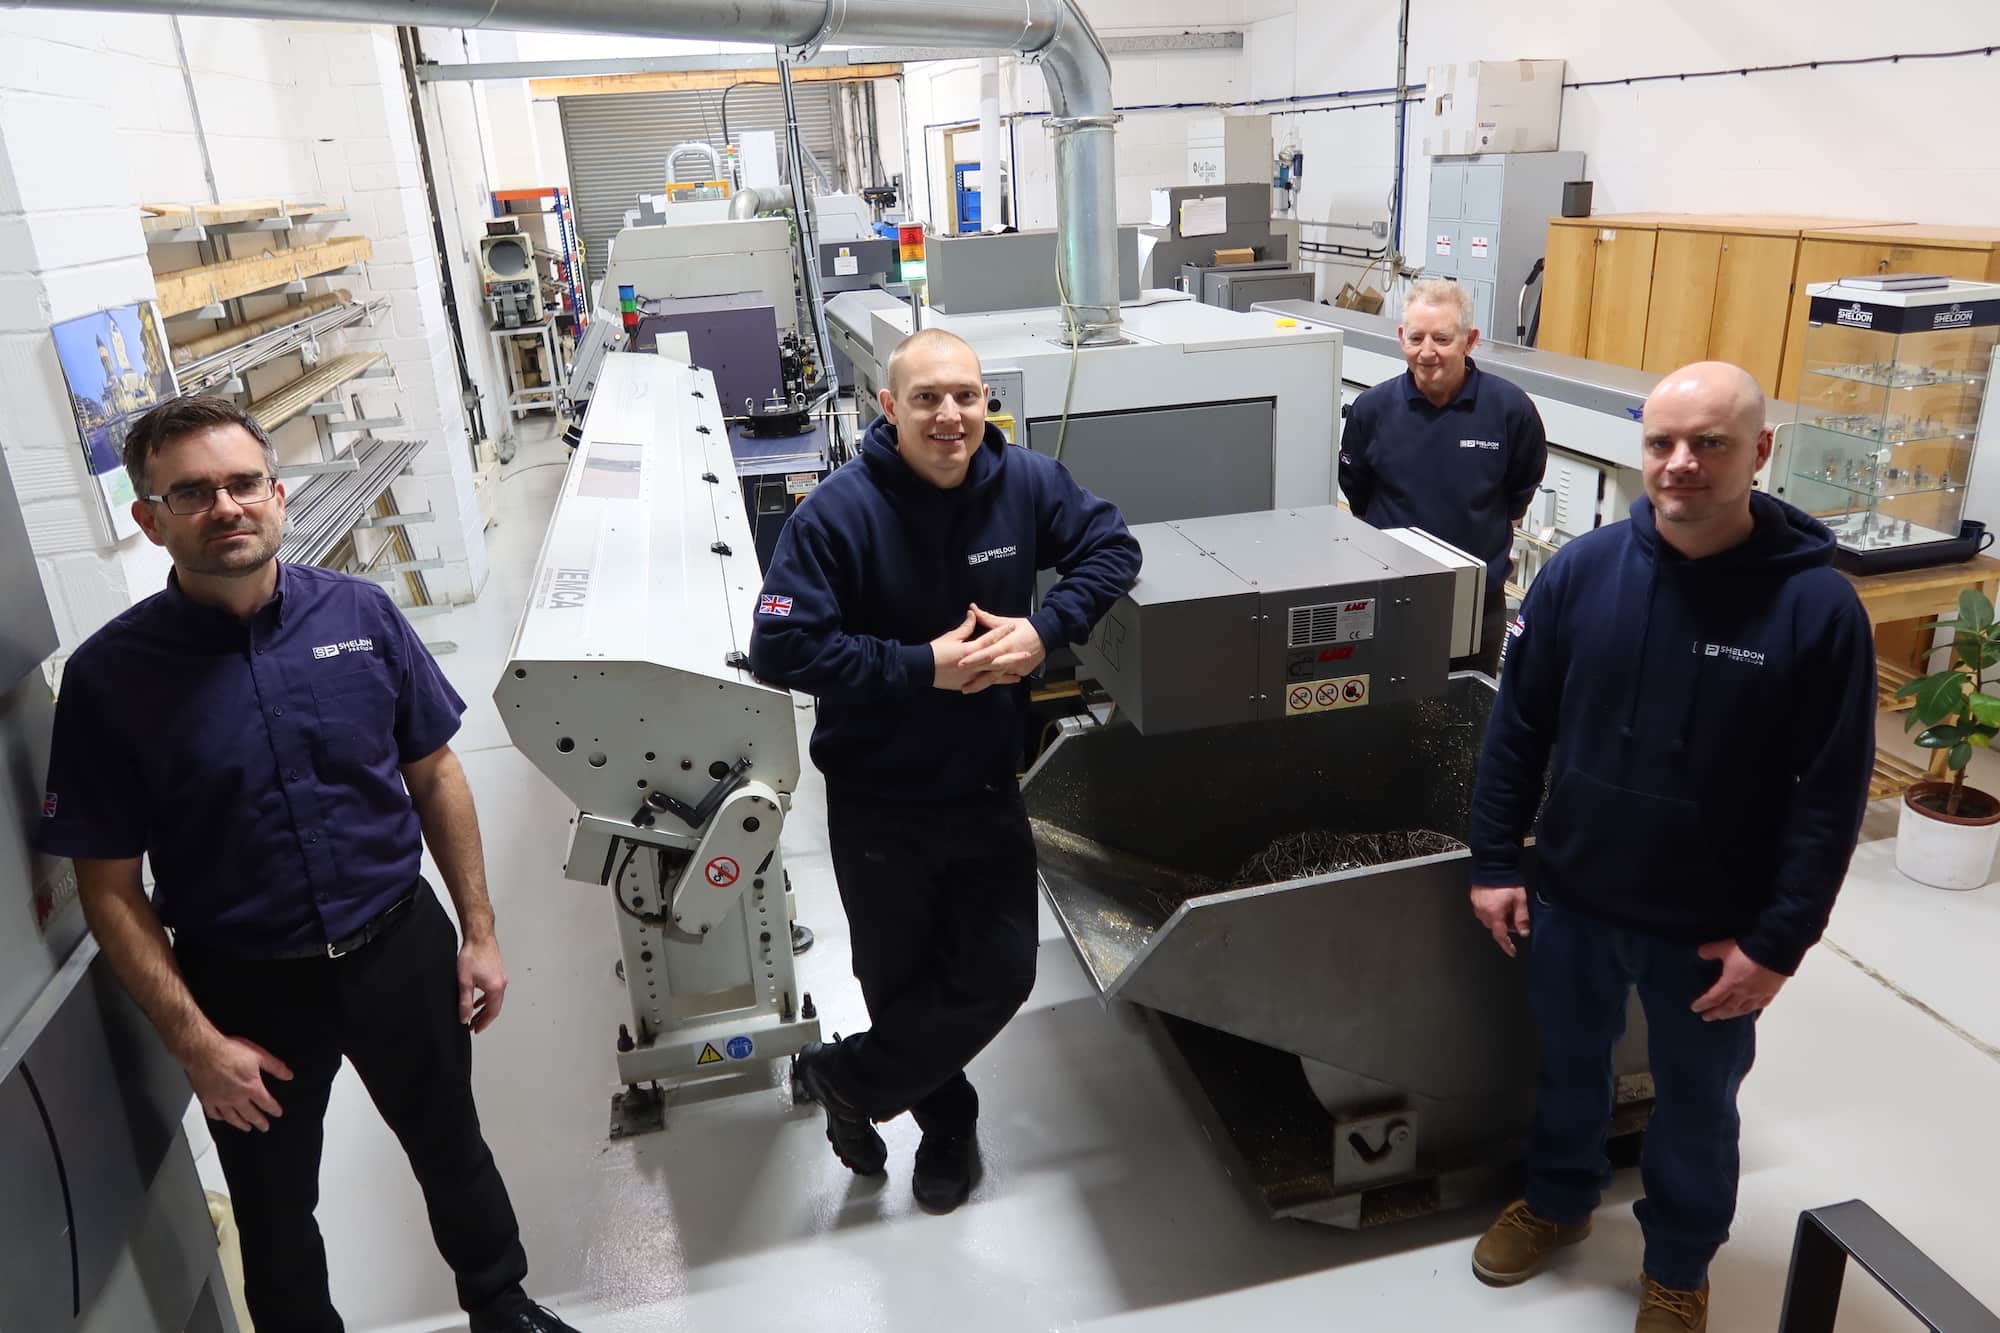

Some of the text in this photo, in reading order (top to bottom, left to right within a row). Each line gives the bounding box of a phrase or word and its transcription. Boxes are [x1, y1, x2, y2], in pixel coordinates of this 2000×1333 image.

[1838, 311, 1872, 323] SHELDON
[1934, 312, 1973, 323] SHELDON
[549, 568, 590, 609] IEMCA
[1720, 646, 1765, 660] SHELDON
